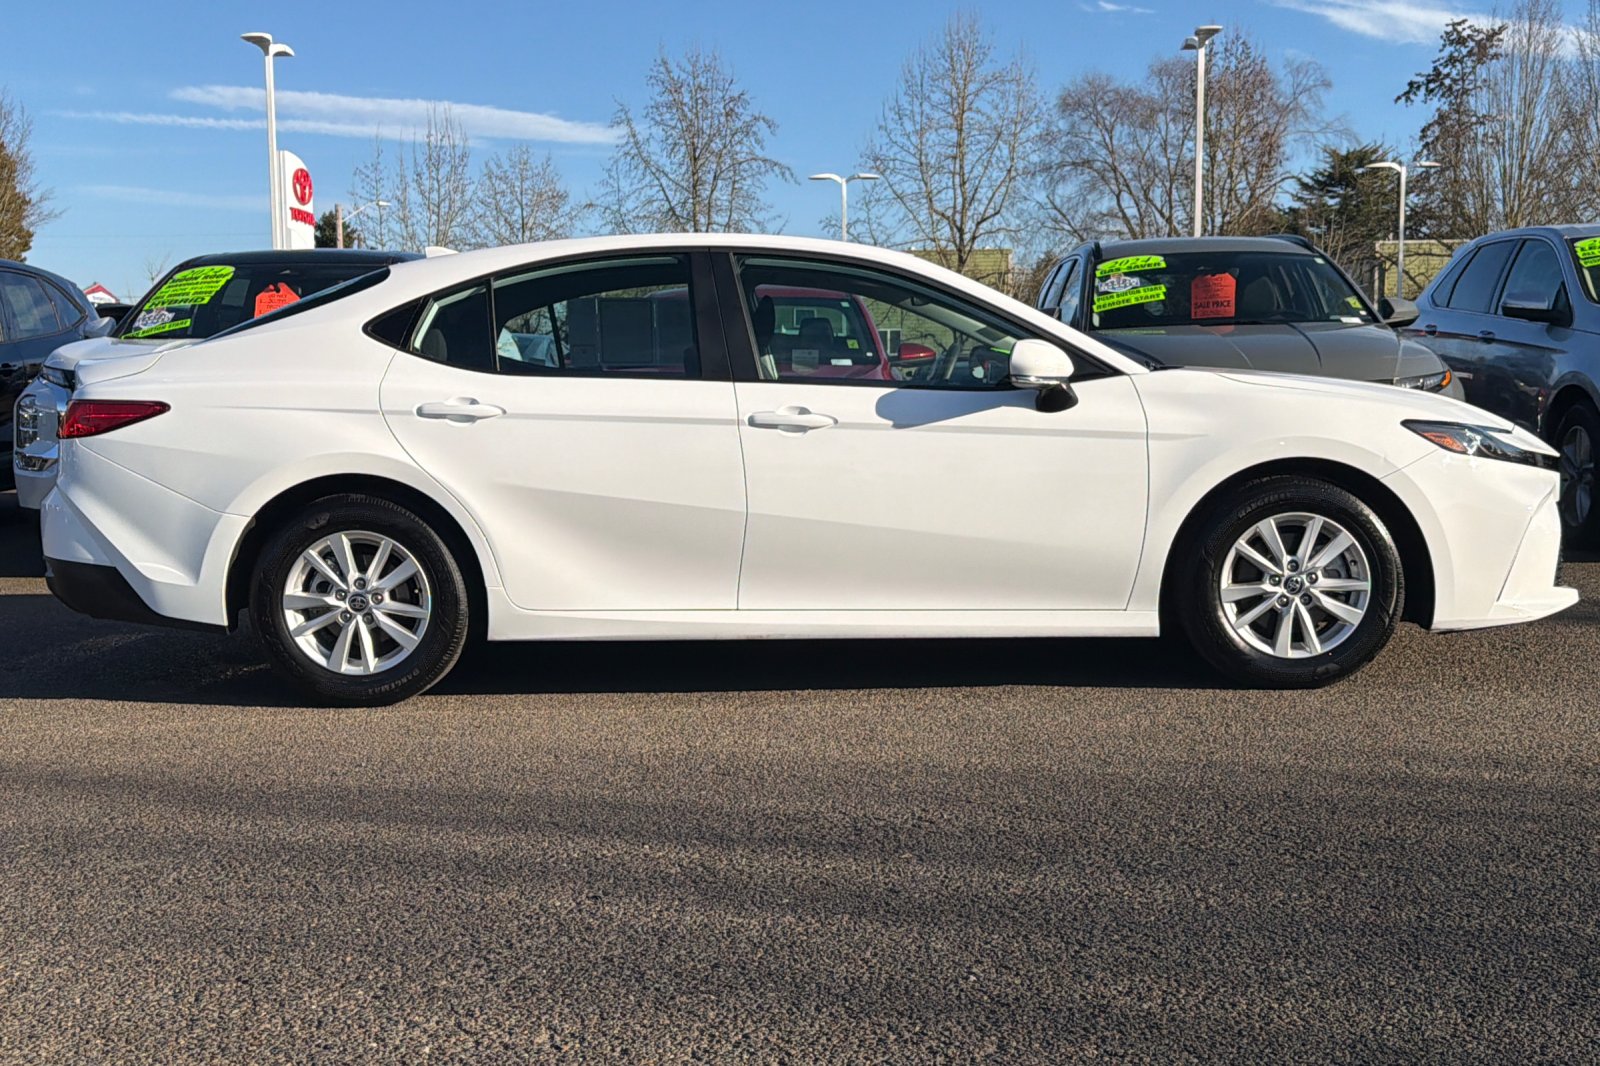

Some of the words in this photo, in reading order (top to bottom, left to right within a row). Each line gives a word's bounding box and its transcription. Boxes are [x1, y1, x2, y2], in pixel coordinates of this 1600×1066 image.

[1126, 261, 1161, 270] SAVER
[1096, 295, 1115, 303] PUSH
[1116, 289, 1141, 298] BUTTON
[1143, 286, 1163, 294] START
[148, 296, 205, 308] HYBRID
[1097, 298, 1133, 310] REMOTE
[1134, 293, 1162, 302] START
[1194, 301, 1210, 309] SALE
[1212, 299, 1232, 308] PRICE
